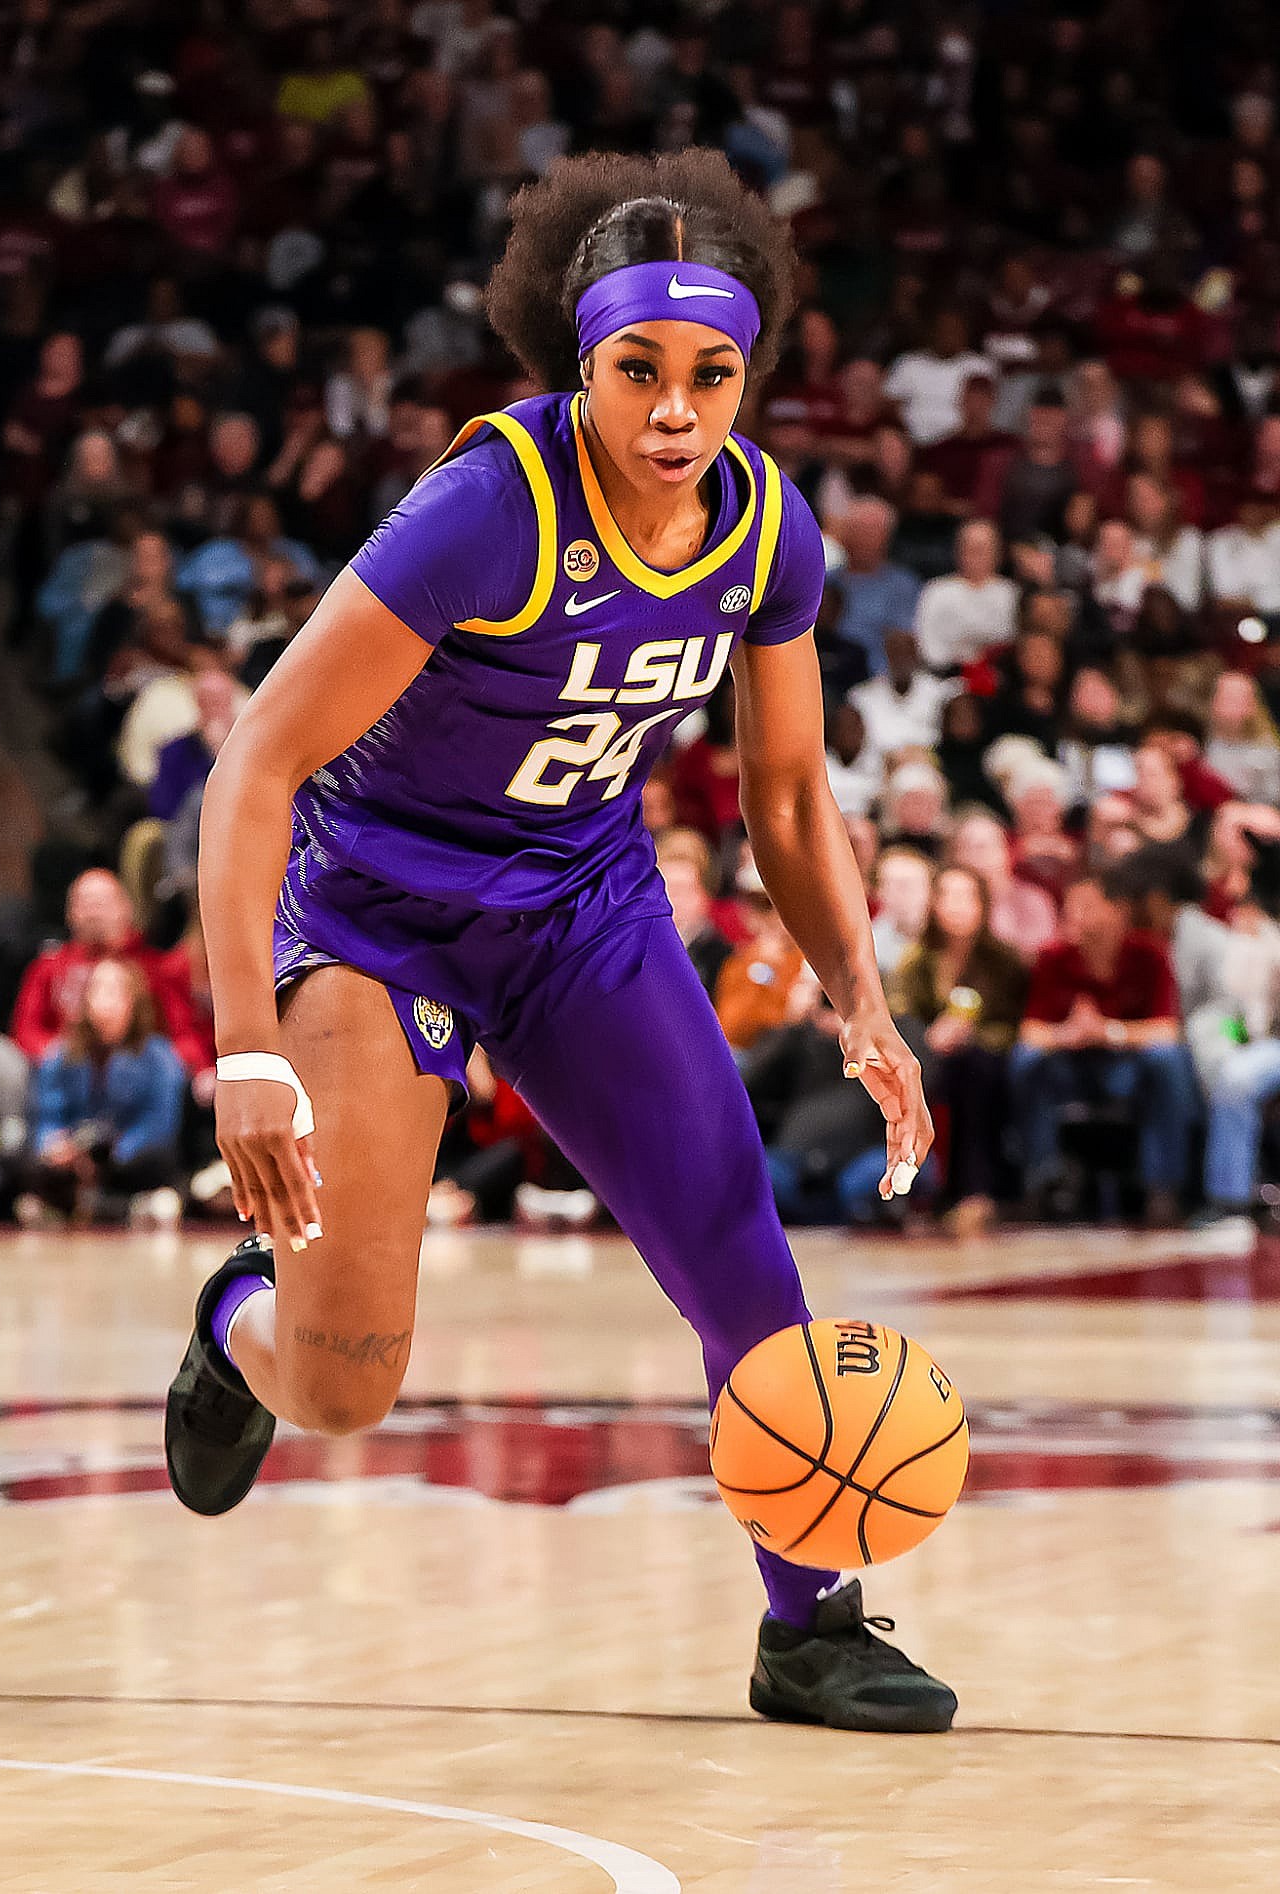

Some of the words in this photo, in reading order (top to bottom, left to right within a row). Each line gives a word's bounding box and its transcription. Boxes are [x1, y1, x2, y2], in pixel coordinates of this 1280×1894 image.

[567, 549, 594, 572] 50
[721, 587, 749, 611] SEC
[558, 632, 734, 704] LSU
[504, 708, 684, 806] 24
